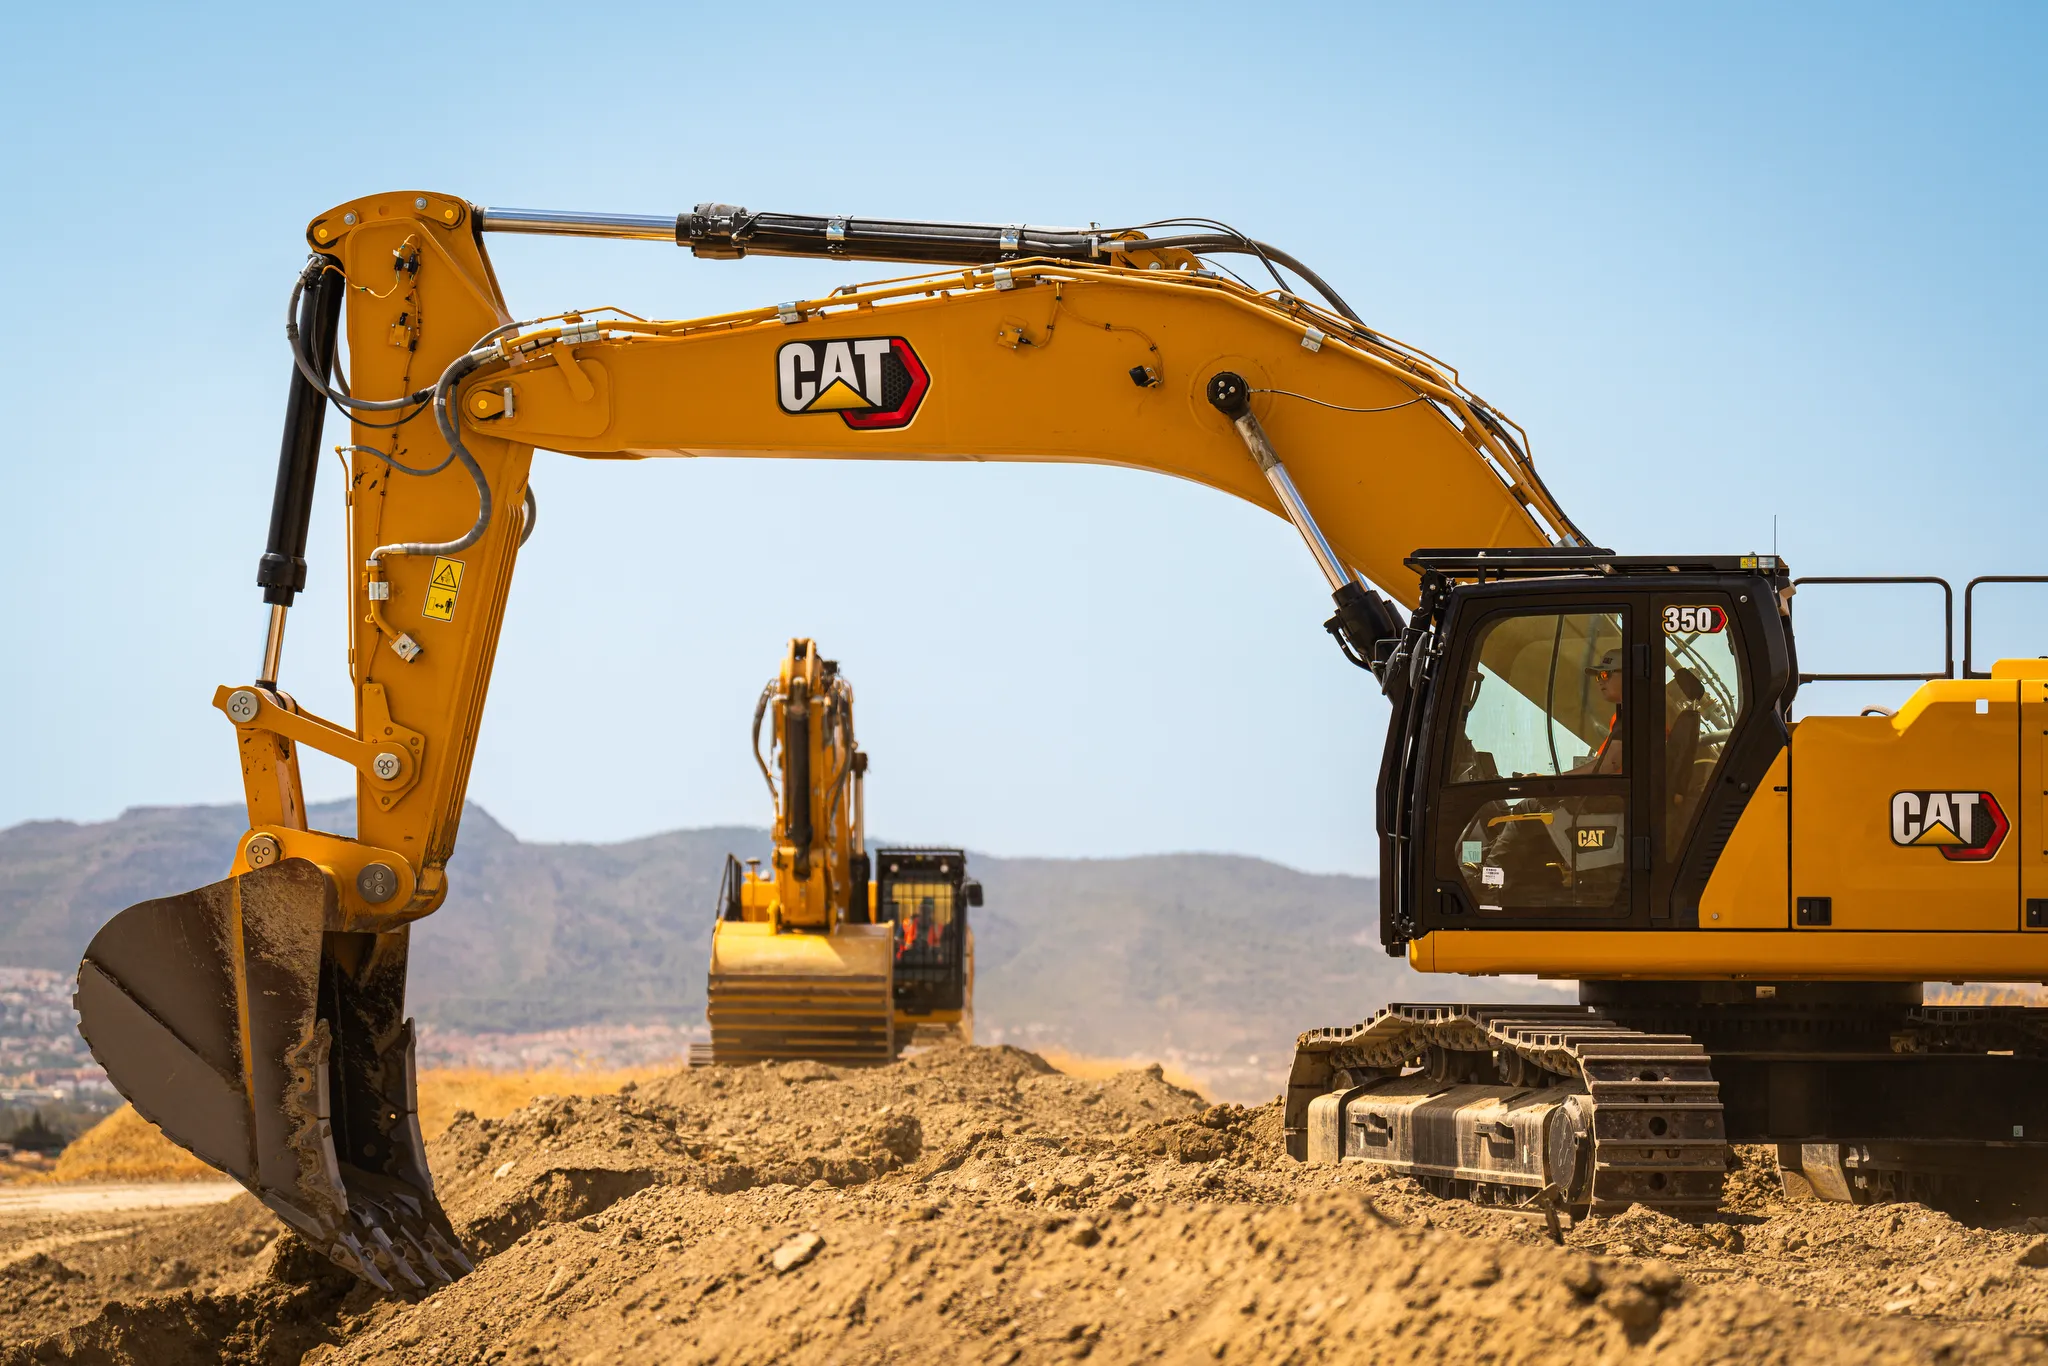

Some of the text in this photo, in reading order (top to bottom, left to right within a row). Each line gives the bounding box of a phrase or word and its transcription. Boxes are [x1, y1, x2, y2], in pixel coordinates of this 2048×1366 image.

[779, 339, 890, 411] CAT
[1665, 607, 1711, 632] 350
[1892, 792, 1979, 844] CAT
[1577, 829, 1605, 847] CAT
